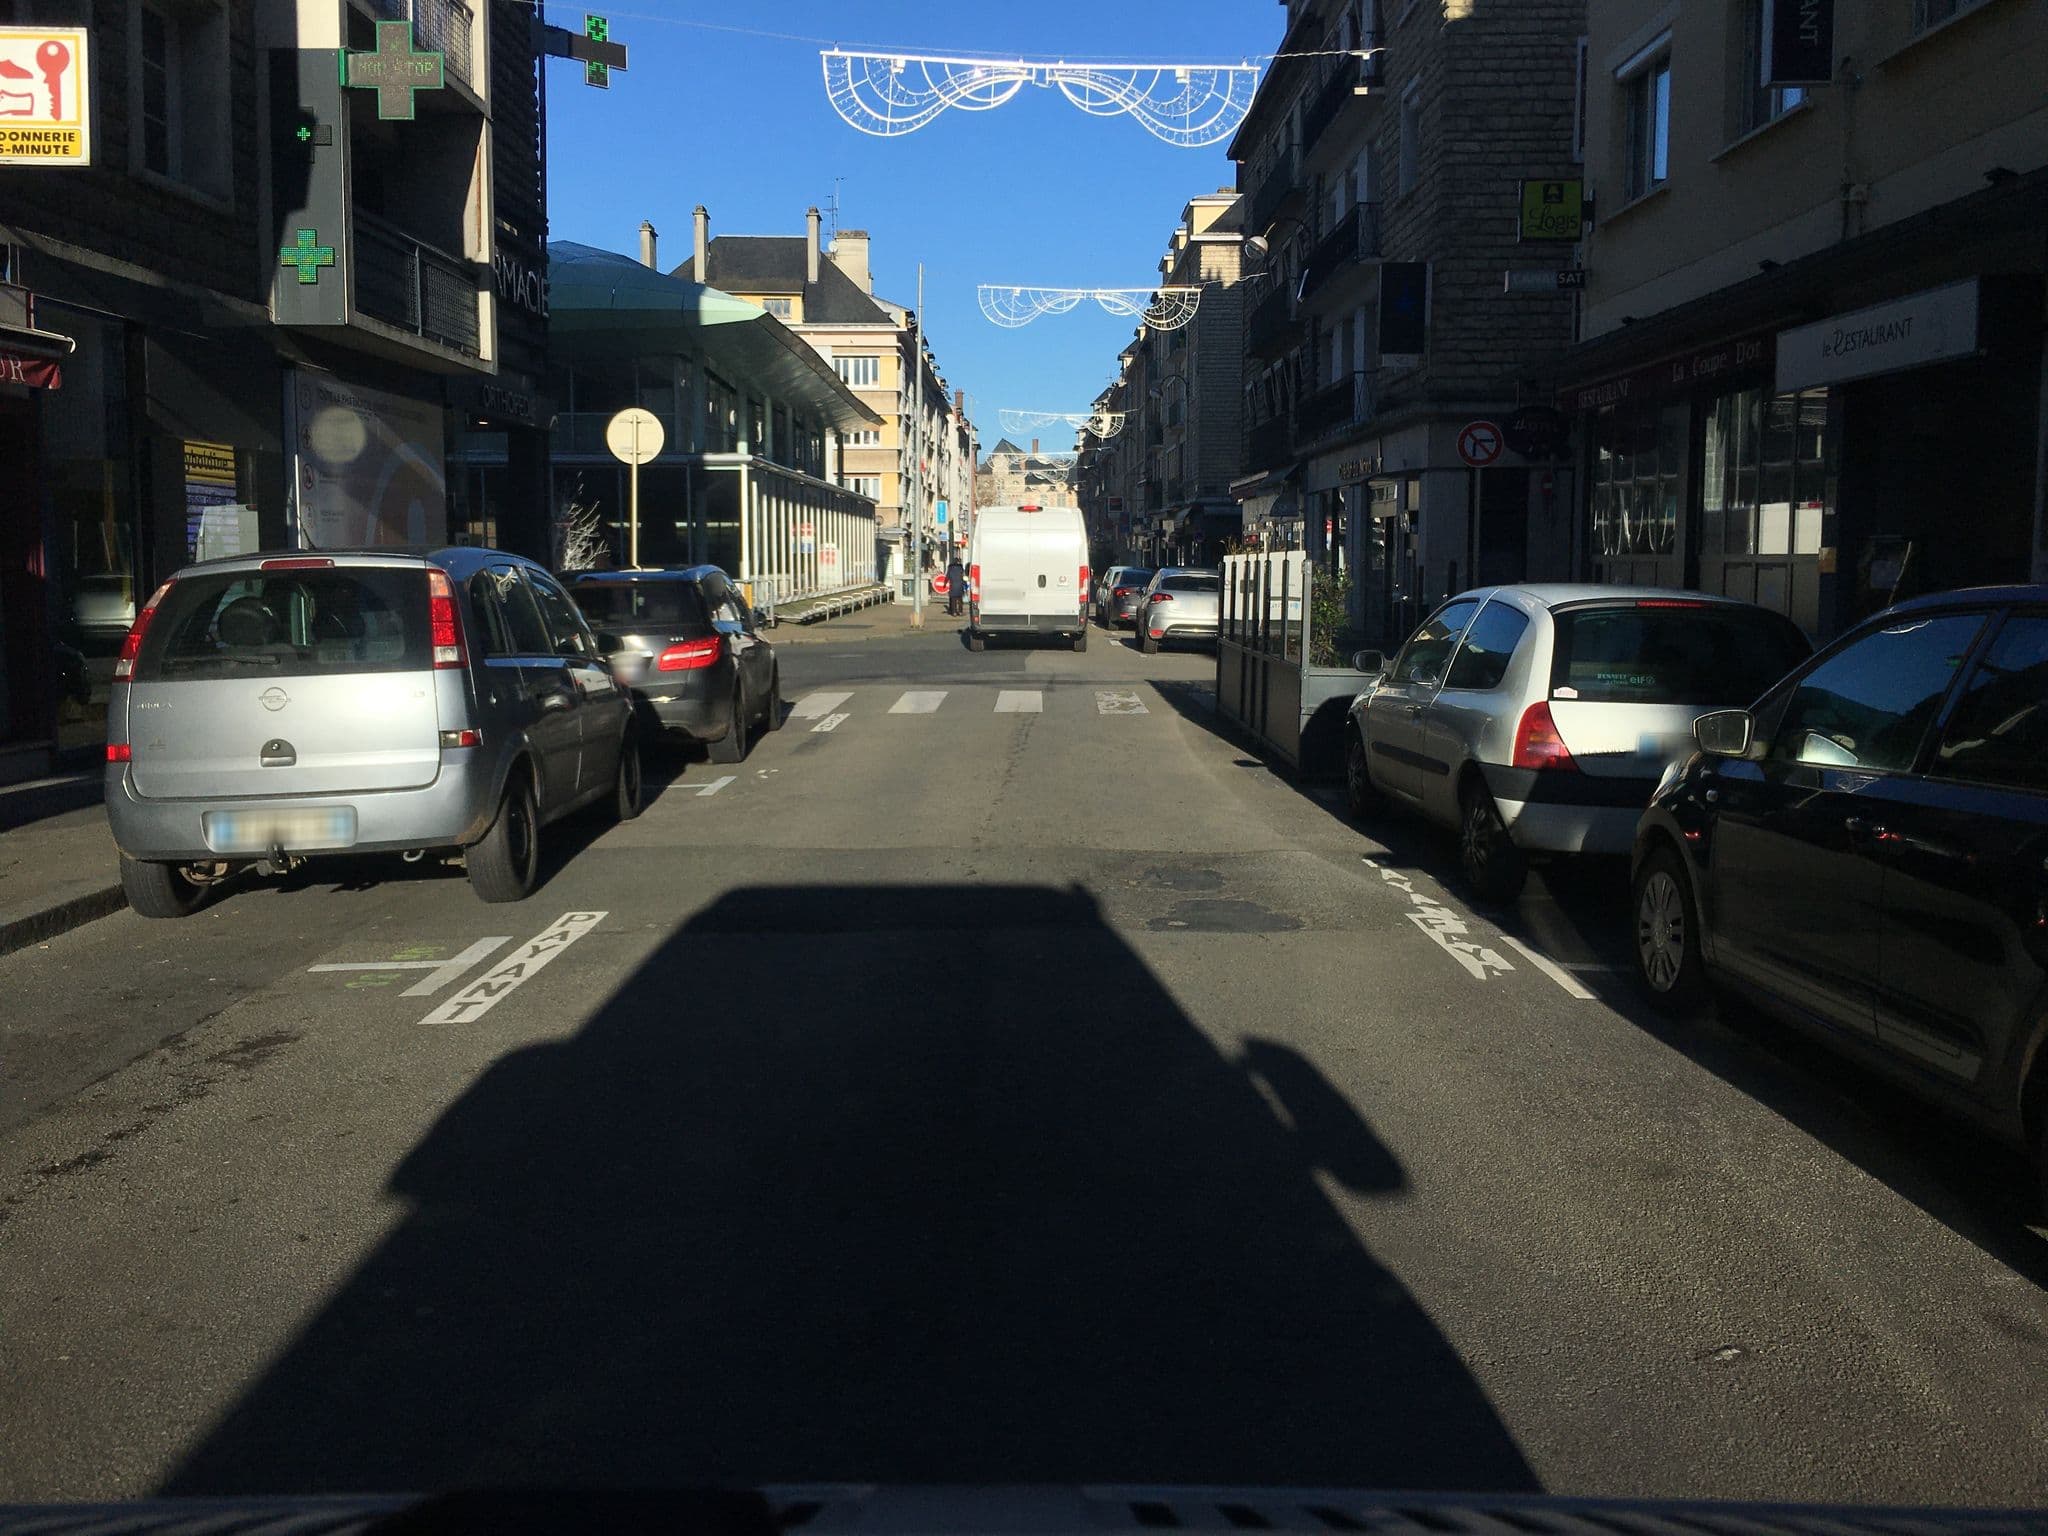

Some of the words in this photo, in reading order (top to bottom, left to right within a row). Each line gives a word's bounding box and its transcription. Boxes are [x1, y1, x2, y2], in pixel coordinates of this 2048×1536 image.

[1526, 204, 1578, 234] Logis
[1833, 317, 1913, 356] RESTAURANT
[1577, 378, 1632, 408] RESTAURANT
[444, 912, 598, 1022] PAYANT
